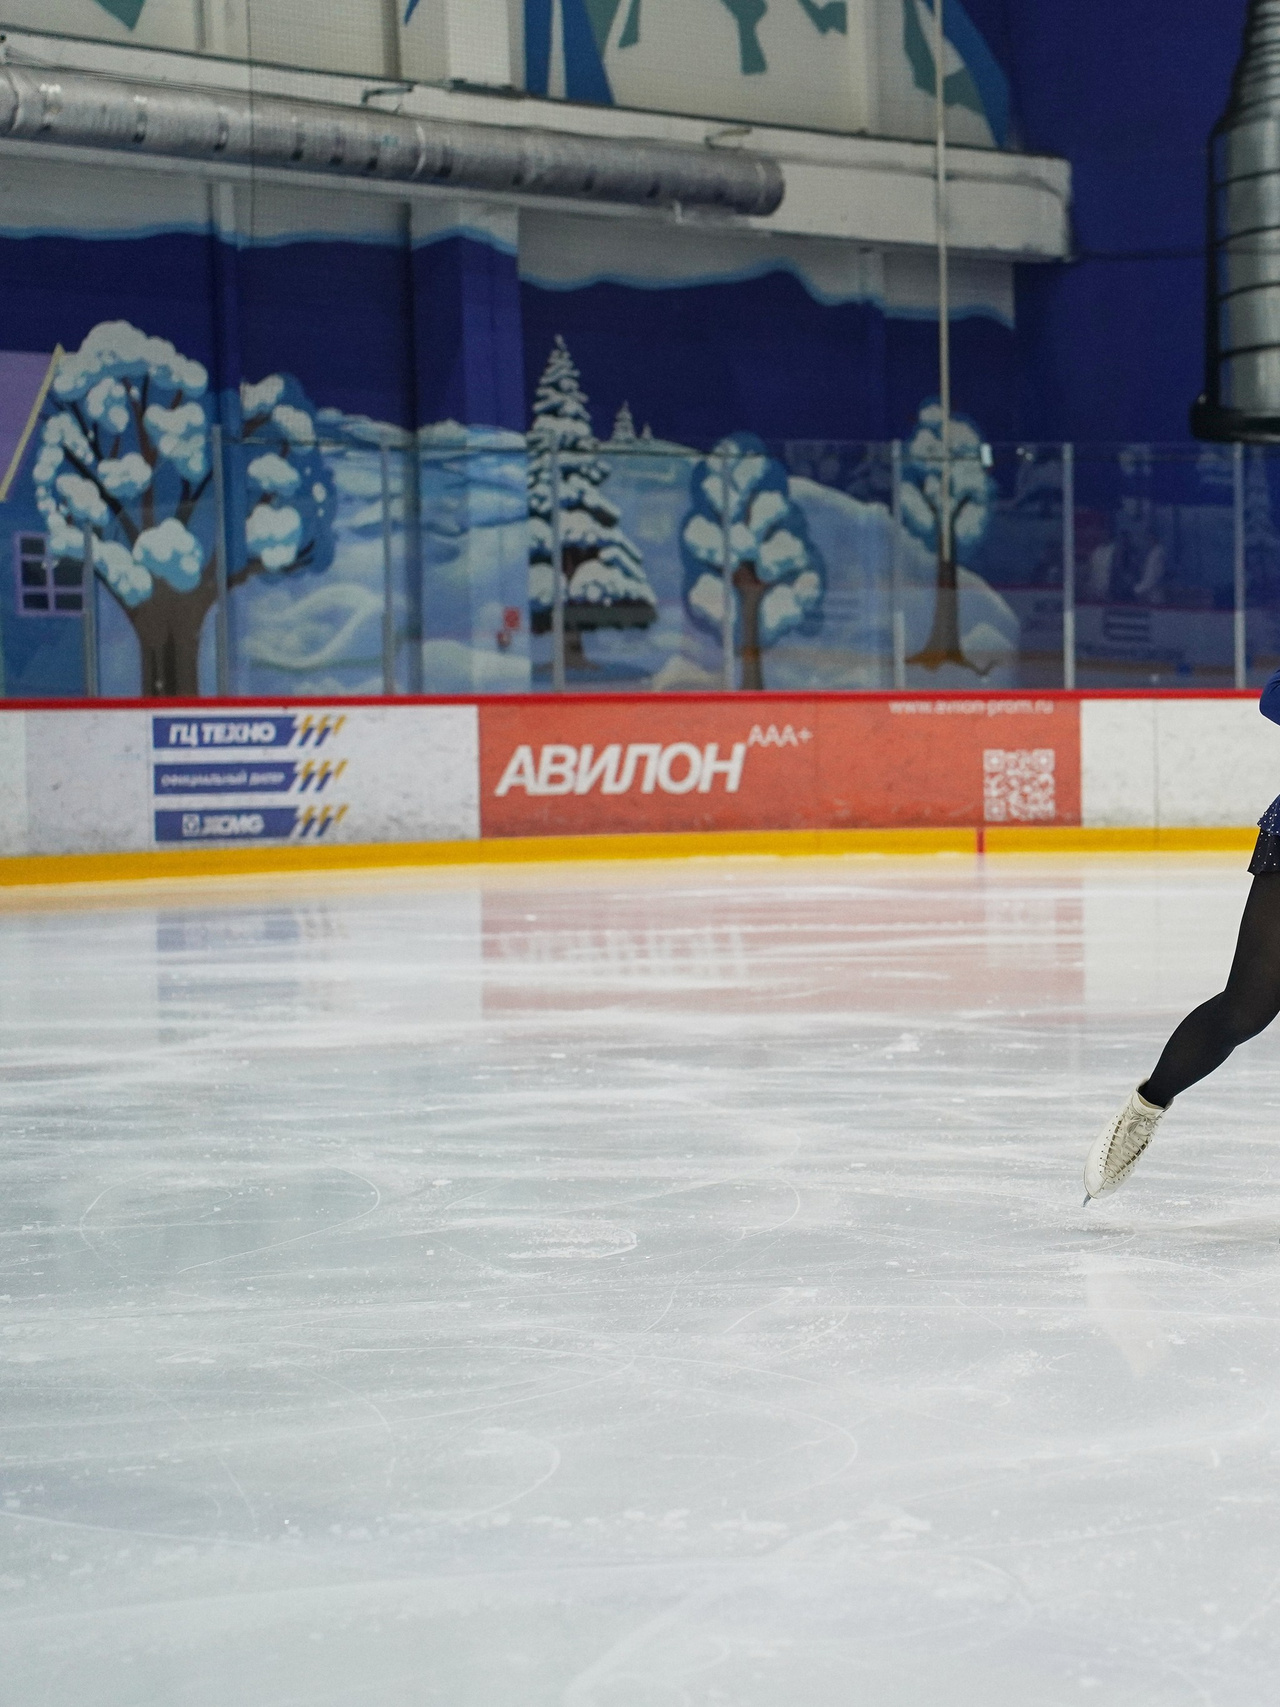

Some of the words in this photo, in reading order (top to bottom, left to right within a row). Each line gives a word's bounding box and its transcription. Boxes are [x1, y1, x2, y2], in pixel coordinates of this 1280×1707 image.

[169, 722, 198, 747] ГЦ
[202, 721, 277, 743] ТЕХНО
[747, 724, 813, 748] AAA+
[494, 742, 746, 796] АВИЛОН
